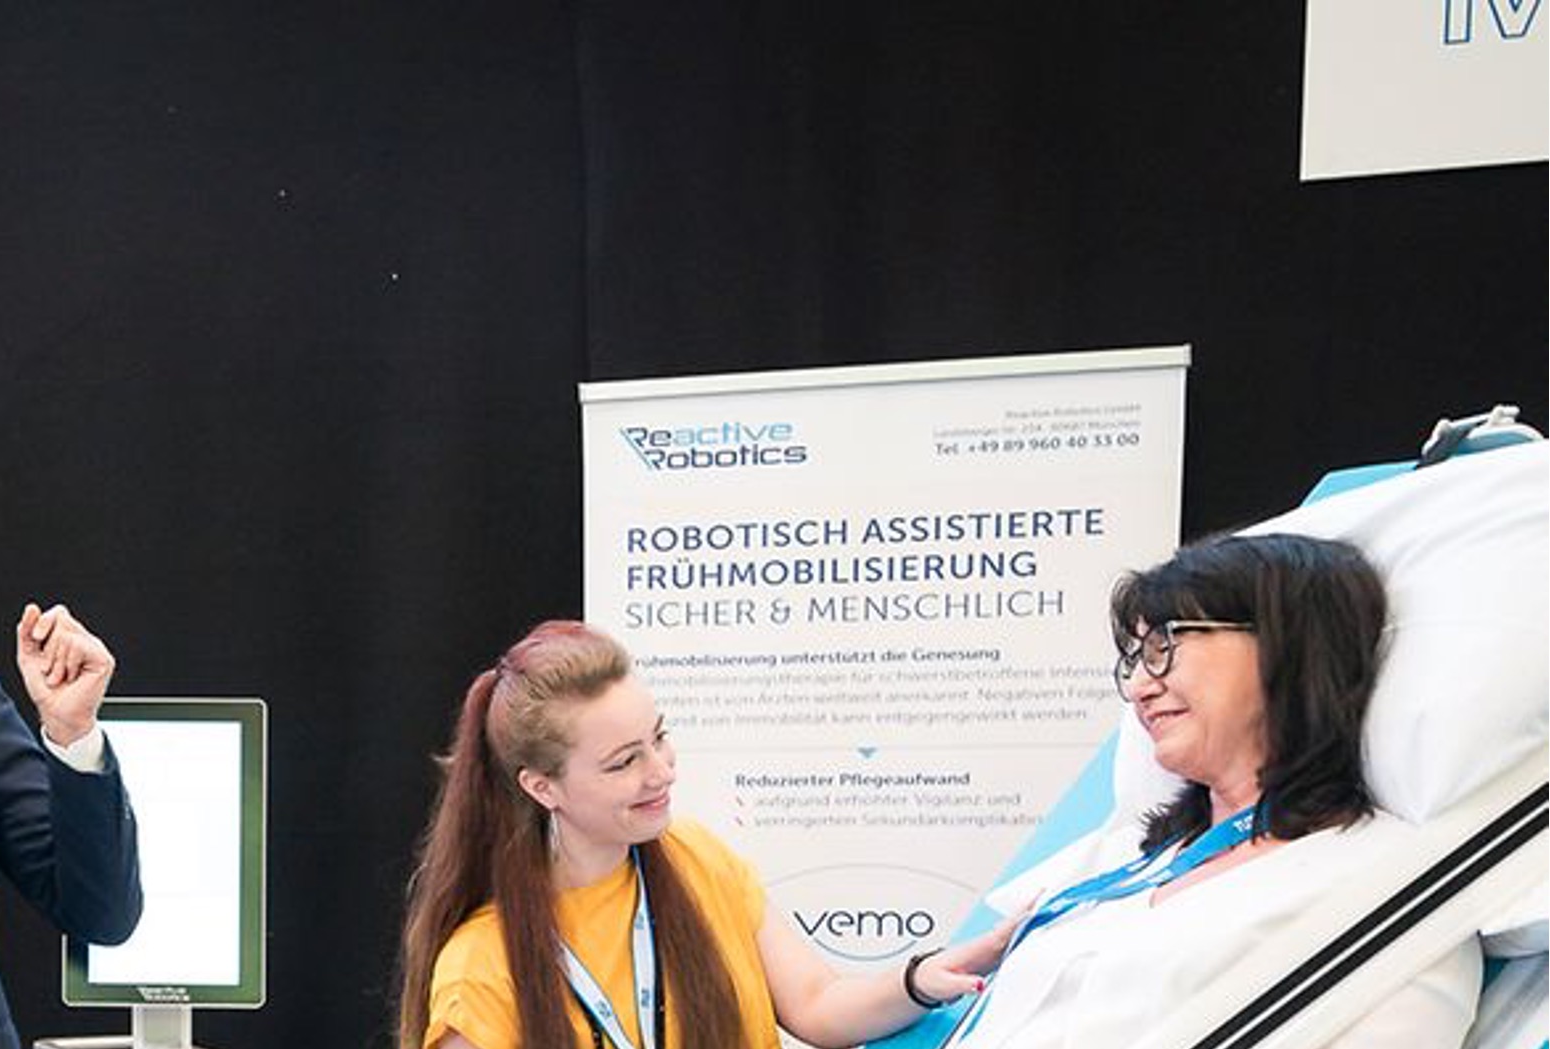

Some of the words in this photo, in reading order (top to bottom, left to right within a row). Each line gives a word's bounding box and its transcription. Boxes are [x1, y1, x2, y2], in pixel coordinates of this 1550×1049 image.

[623, 421, 793, 447] Reactive
[1002, 439, 1025, 451] 89
[1028, 436, 1061, 450] 960
[1066, 436, 1087, 448] 40
[1093, 434, 1112, 447] 33
[1116, 432, 1140, 446] 00
[644, 444, 807, 470] Robotics
[627, 519, 848, 553] ROBOTISCH
[861, 508, 1104, 544] ASSISTIERTE
[627, 550, 1038, 590] FRÜHMOBILISIERUNG
[625, 600, 757, 629] SICHER
[769, 597, 791, 624] &
[807, 590, 1064, 622] MENSCHLICH
[635, 653, 778, 668] rühmobilisierung
[781, 650, 876, 665] unterstützt
[881, 649, 907, 662] die
[911, 648, 1000, 664] Genesung
[735, 773, 834, 788] Reduzierter
[839, 771, 971, 789] Pflegeaufwand
[793, 909, 935, 939] vemo
